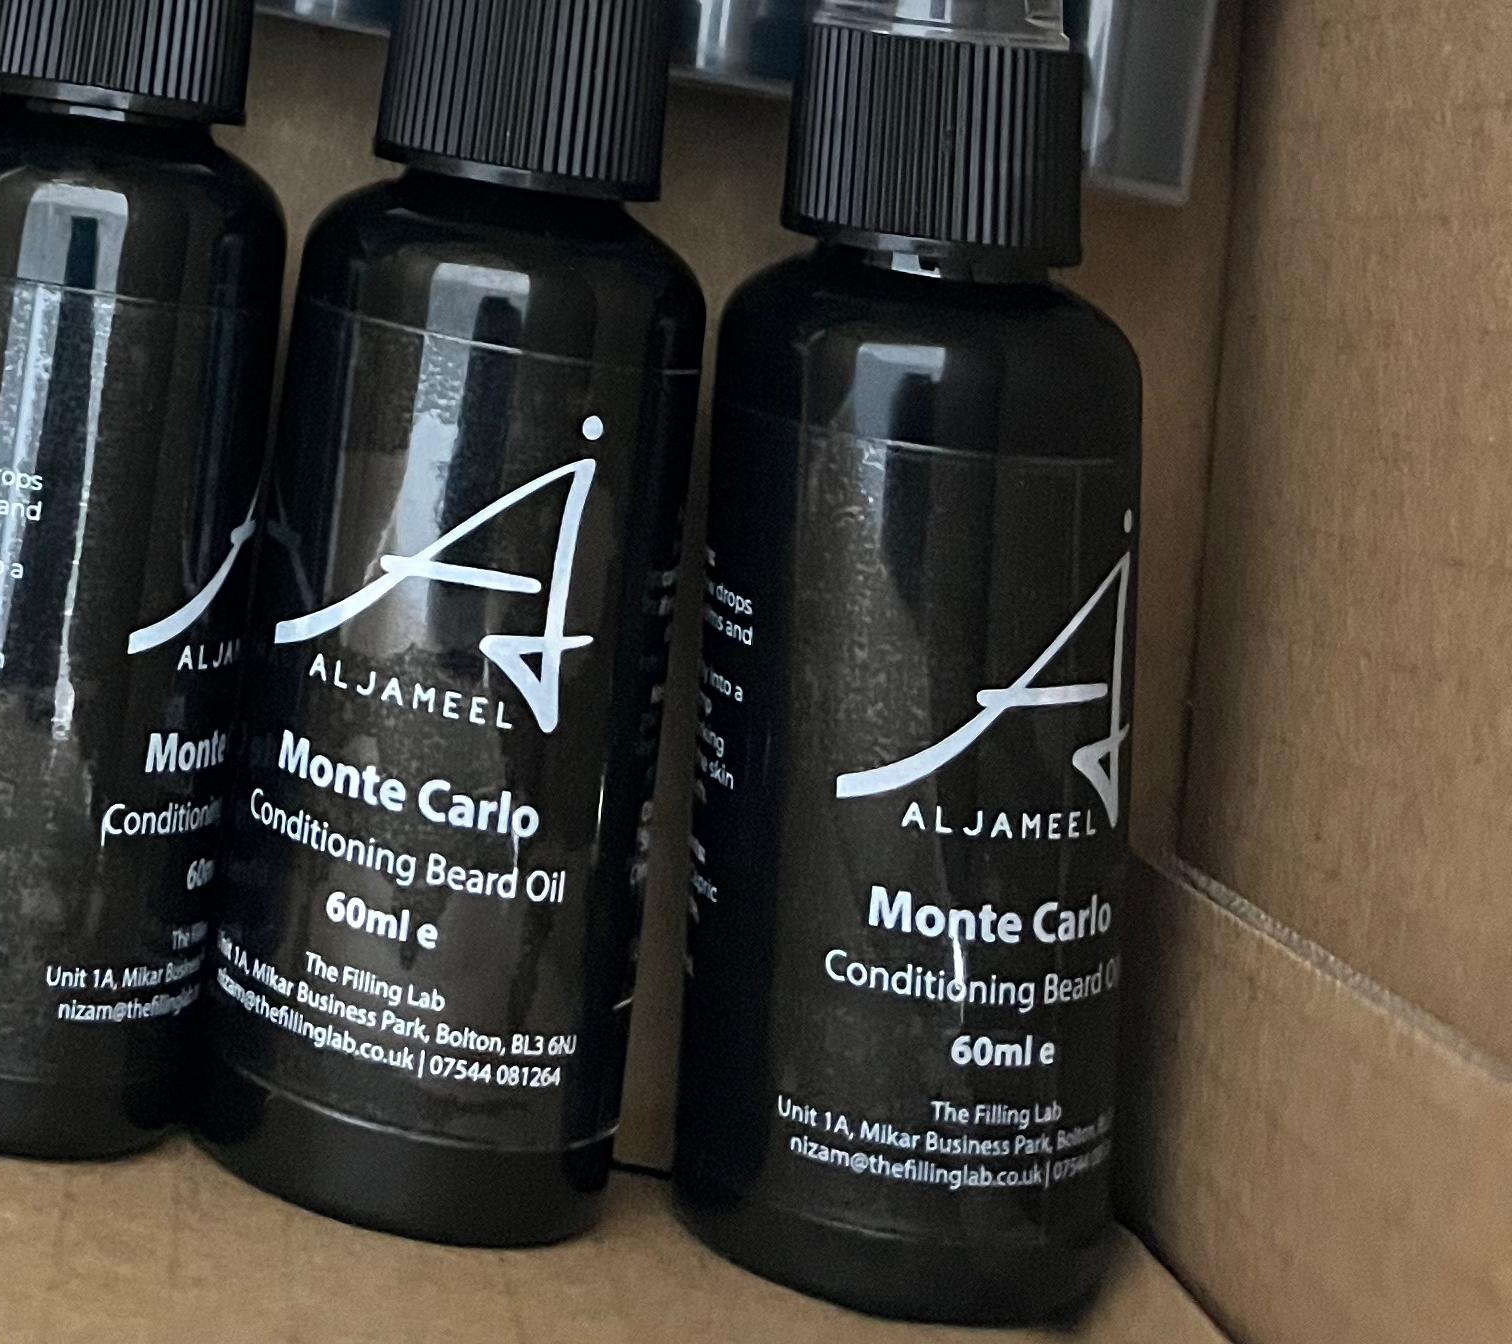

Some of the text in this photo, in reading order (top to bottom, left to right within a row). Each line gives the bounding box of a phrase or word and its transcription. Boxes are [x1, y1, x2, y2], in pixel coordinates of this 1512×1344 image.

[11, 563, 24, 579] a
[715, 583, 753, 614] drops
[725, 621, 753, 647] and
[309, 653, 512, 730] ALJAMEEL
[145, 730, 227, 773] Monte
[278, 730, 539, 838] Monte Carlo
[901, 801, 1097, 840] ALJAMEEL
[250, 788, 566, 903] Conditioning Beard Oil
[326, 891, 409, 942] 60ml
[868, 884, 1112, 944] Monte Carlo
[47, 966, 163, 990] Unit 1A, Mikar
[306, 951, 446, 1012] The Filling Lab
[825, 949, 1101, 1014] Conditioning Beard
[252, 958, 294, 997] Mikar
[296, 986, 377, 1028] Business
[381, 1012, 430, 1044] Park,
[436, 1023, 506, 1056] Bolton,
[511, 1033, 544, 1056] BL3
[429, 1055, 491, 1083] 07544
[496, 1066, 560, 1086] 081264
[951, 1035, 1033, 1067] 60ml
[777, 1094, 816, 1128] Unit
[825, 1112, 854, 1139] 1A,
[860, 1120, 918, 1150] Mikar
[925, 1131, 1010, 1156] Business
[930, 1100, 1062, 1130] The Filling Lab
